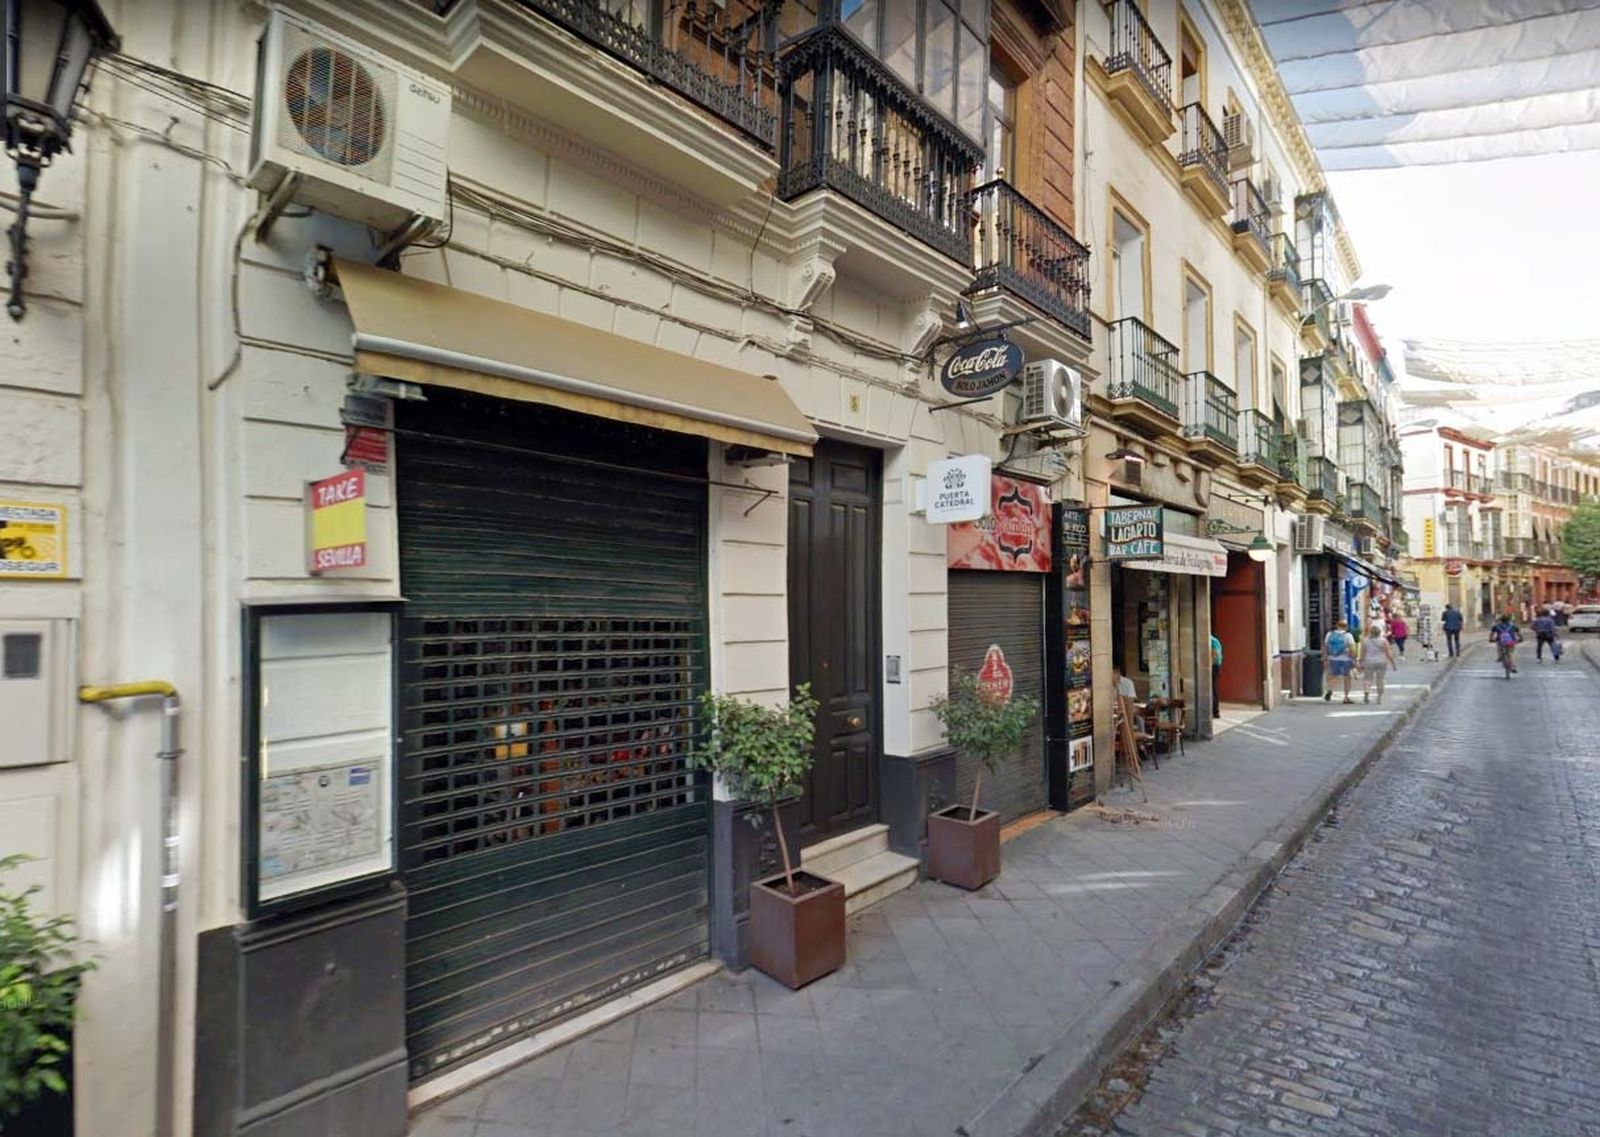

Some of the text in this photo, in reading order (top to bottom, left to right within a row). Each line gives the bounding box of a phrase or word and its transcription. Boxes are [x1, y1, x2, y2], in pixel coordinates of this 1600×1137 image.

[947, 344, 1010, 379] Coca-Cola
[318, 476, 360, 506] TAKE
[939, 490, 970, 501] PUERTA
[934, 498, 974, 509] CATEDRAL
[1110, 509, 1153, 525] TABERNA
[1111, 521, 1157, 543] LAGARTO
[317, 546, 363, 568] SEVILLA
[1109, 544, 1128, 556] BAR
